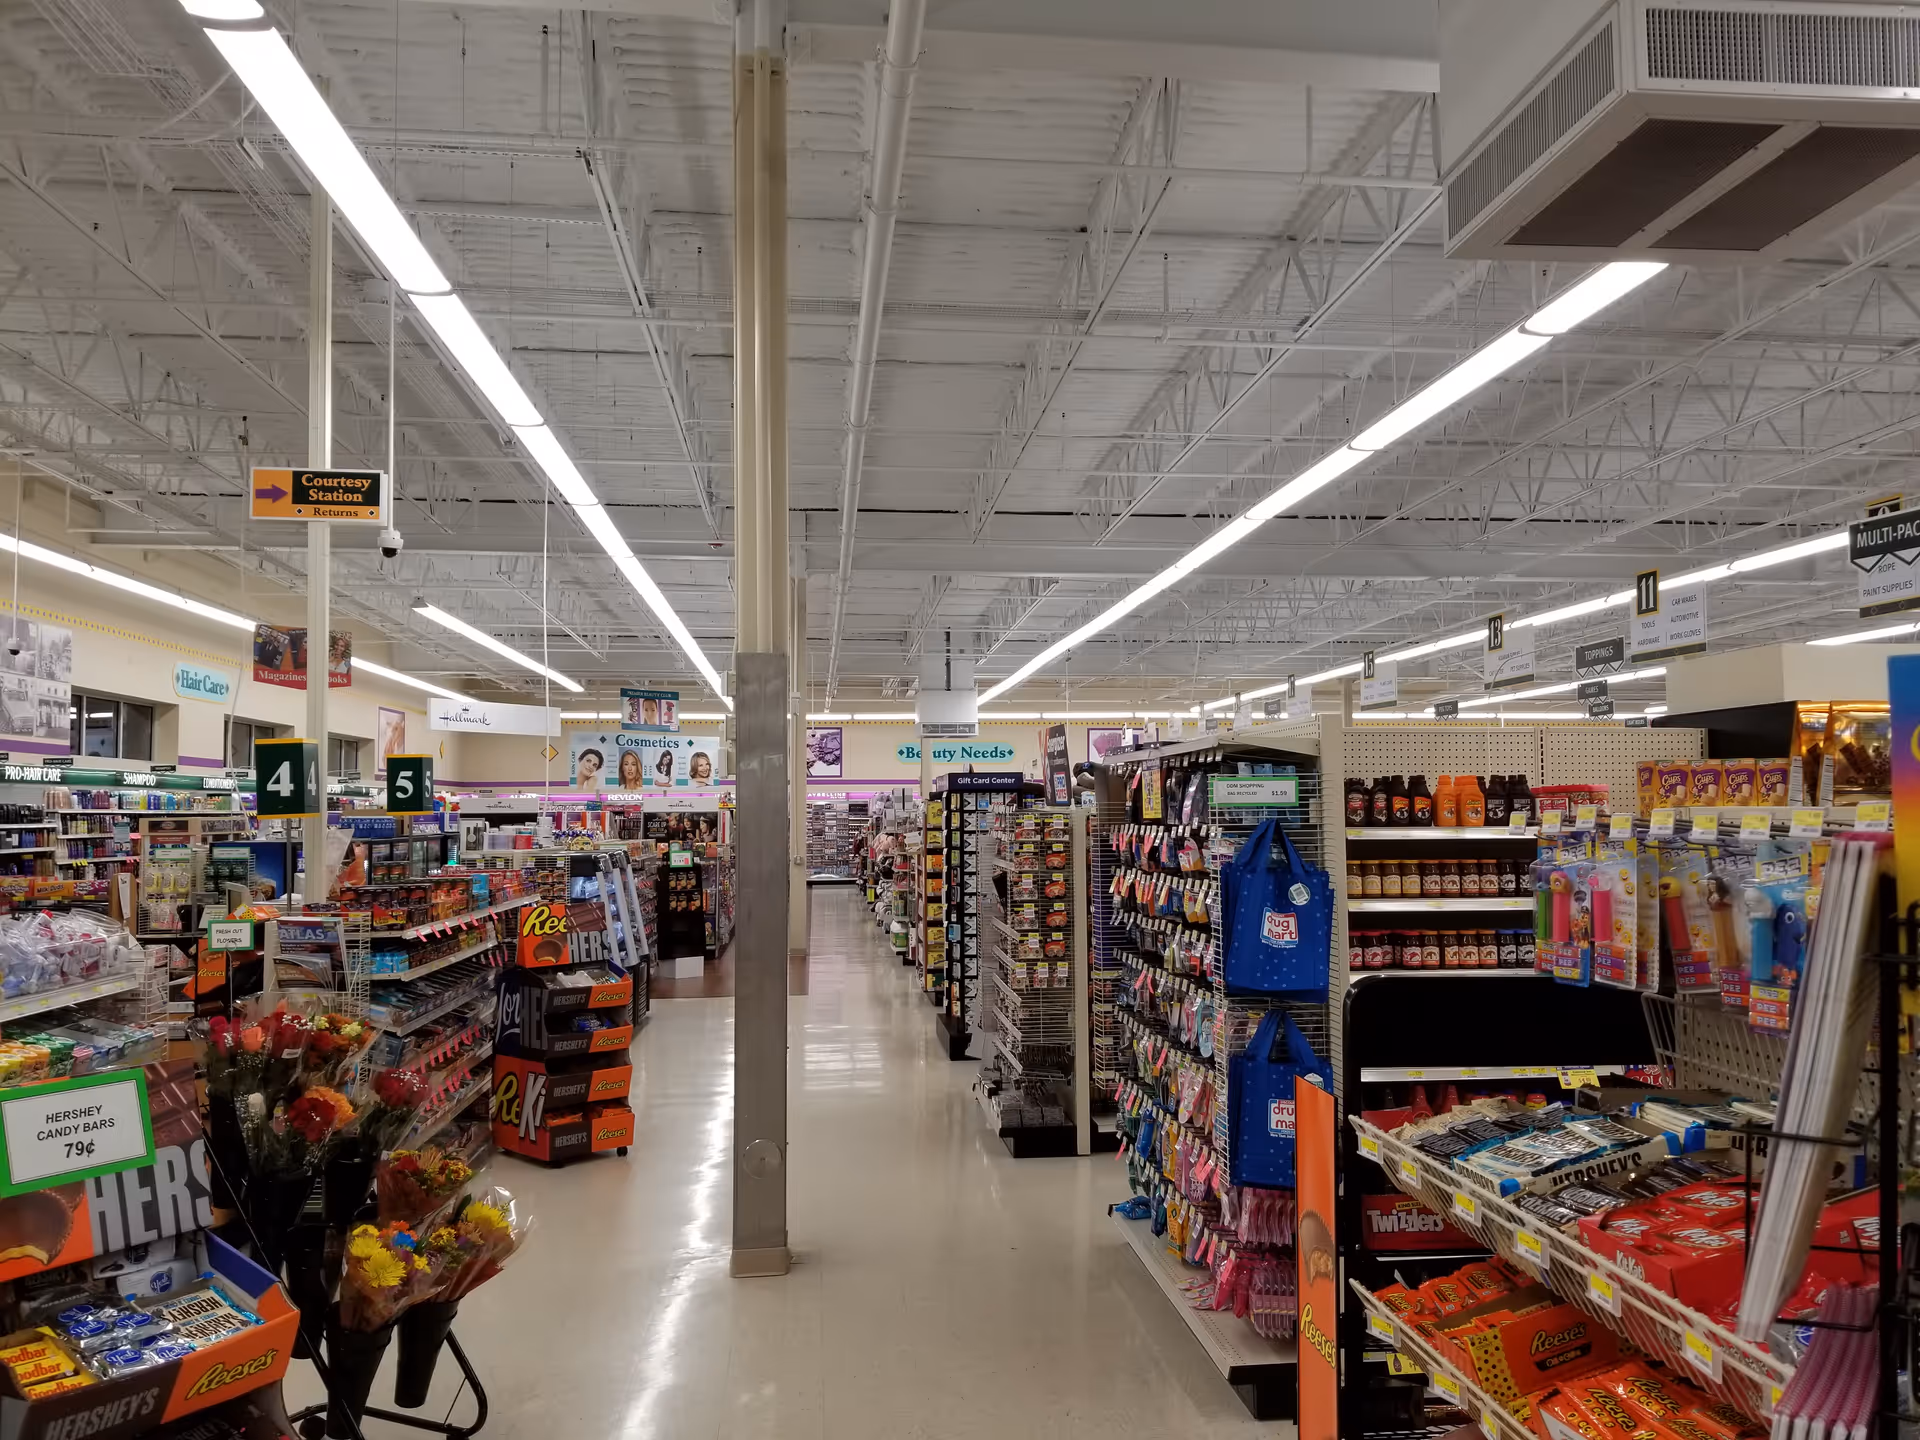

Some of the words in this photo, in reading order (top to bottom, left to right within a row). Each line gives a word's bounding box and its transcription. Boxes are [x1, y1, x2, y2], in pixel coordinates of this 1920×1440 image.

[301, 474, 371, 491] Courtesy
[308, 488, 363, 502] Station
[313, 507, 359, 517] Returns
[1879, 562, 1896, 573] ROPE
[1640, 575, 1655, 610] 11
[1863, 586, 1881, 597] PAINT
[1882, 580, 1913, 594] SUPPLIES
[1671, 597, 1681, 606] CAR
[1641, 620, 1656, 629] TOOLS
[1670, 611, 1699, 623] AUTOMOTIVE
[1490, 619, 1502, 648] 13
[1637, 636, 1660, 646] HARDWARE
[1670, 631, 1683, 641] WORK
[1683, 628, 1702, 638] GLOVES
[1584, 646, 1614, 661] TOPPINGS
[180, 668, 203, 691] Hair
[203, 674, 225, 696] Care
[258, 670, 307, 682] Magazines
[328, 674, 348, 684] ooks
[439, 710, 491, 728] Hallmark
[615, 734, 680, 749] Cosmetics
[905, 746, 956, 762] Beuty
[961, 746, 1007, 759] Needs
[4, 765, 41, 781] PRO-HAIR
[42, 768, 62, 782] CARE
[123, 772, 156, 786] SHAMPOO
[266, 761, 295, 797] 4
[307, 760, 317, 796] 4
[395, 770, 414, 798] 5
[425, 771, 431, 798] 5
[607, 793, 643, 801] REVLON
[279, 928, 325, 940] ATLAS
[1267, 928, 1297, 940] mart
[553, 994, 587, 1007] HERSHEY'S
[554, 1039, 588, 1051] HERSHEY'S
[553, 1084, 586, 1097] HERSHEY'S
[45, 1104, 103, 1125] HERSHEY
[1272, 1100, 1295, 1116] dru
[36, 1124, 81, 1142] CANDY
[82, 1117, 115, 1133] BARS
[1275, 1119, 1295, 1130] ma
[555, 1132, 587, 1148] HERSHEY'S
[63, 1138, 96, 1159] 79¢
[1366, 1208, 1445, 1233] Twizzlers
[71, 1320, 103, 1336] York
[1300, 1303, 1336, 1370] Reese's
[1477, 1335, 1488, 1345] 24
[1530, 1322, 1586, 1356] Reese's
[105, 1350, 140, 1366] York
[186, 1348, 278, 1401] Reese's
